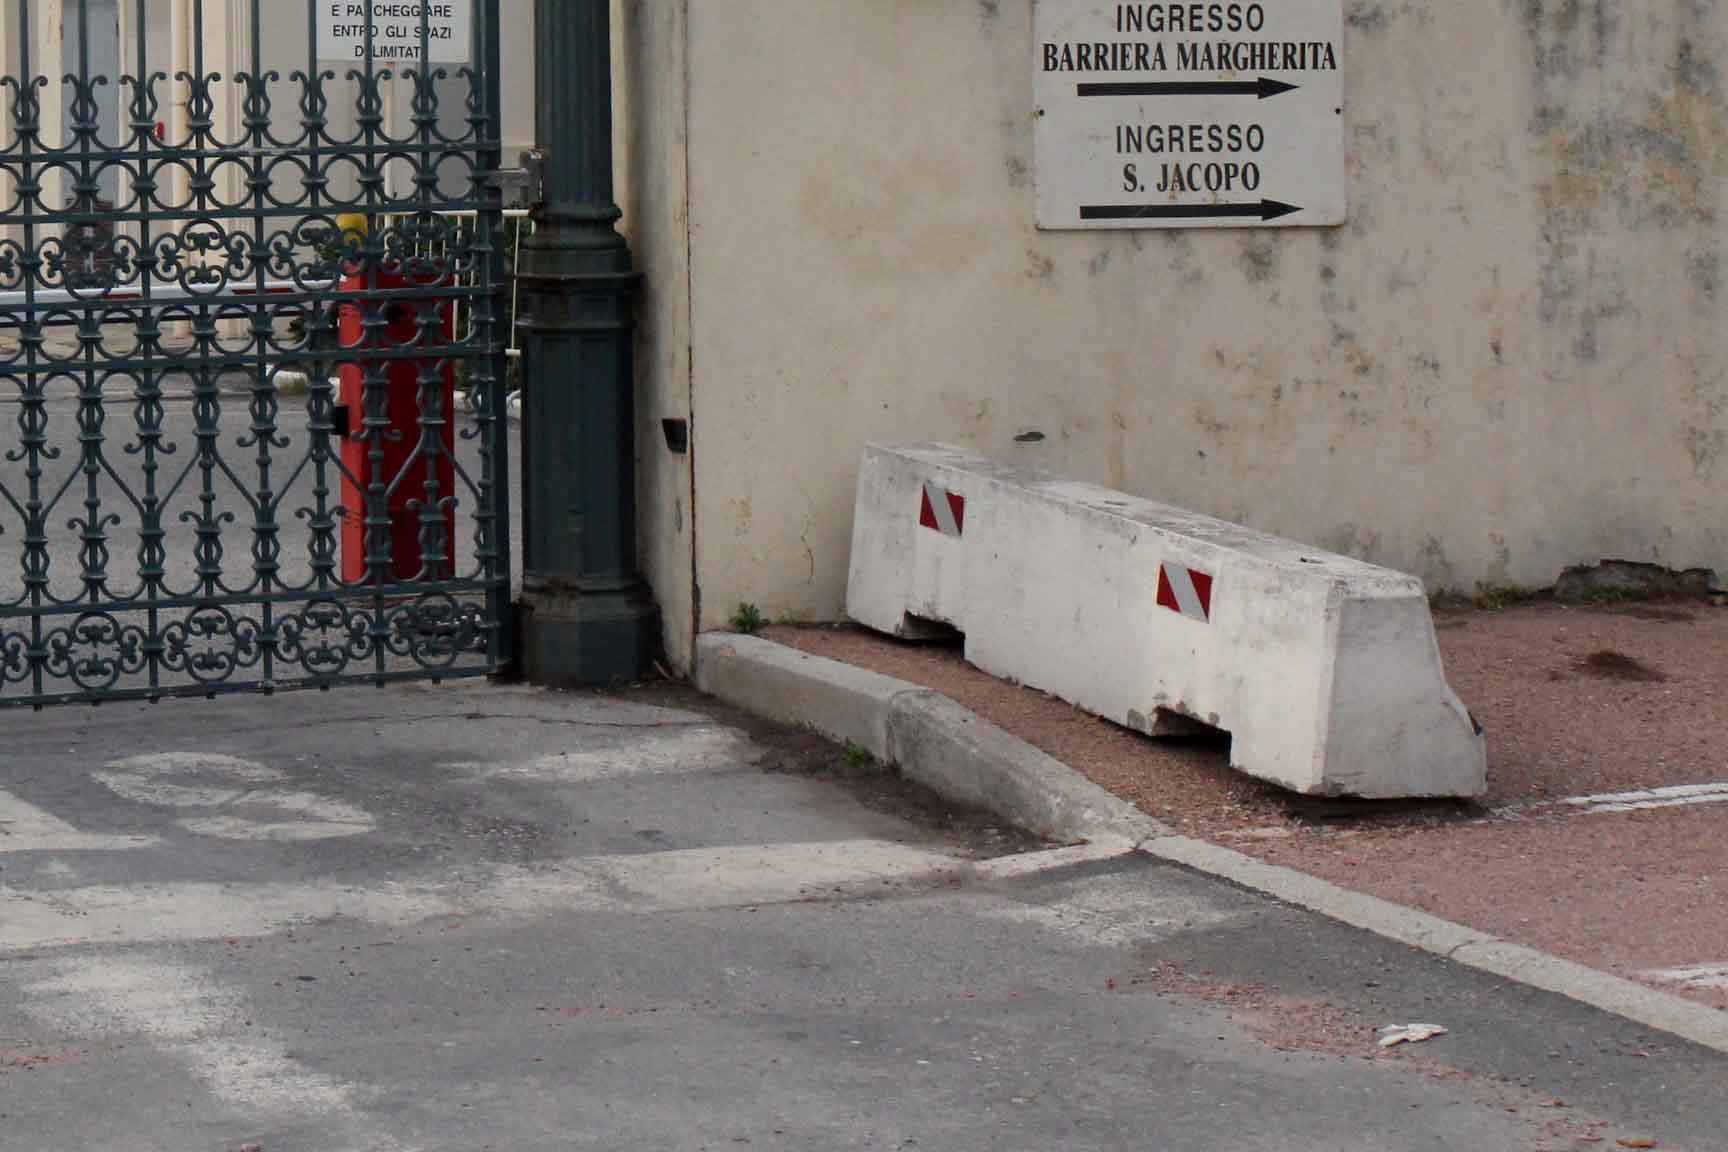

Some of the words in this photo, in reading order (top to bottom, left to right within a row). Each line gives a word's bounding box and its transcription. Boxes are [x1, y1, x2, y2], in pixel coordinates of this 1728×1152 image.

[331, 5, 339, 17] E
[347, 5, 452, 18] PACHEGGARE
[1117, 4, 1264, 33] INGRESSO
[385, 26, 407, 38] GLI
[1042, 42, 1167, 72] BARRIERA
[1176, 41, 1337, 71] MARGHERITA
[1116, 124, 1265, 153] INGRESSO
[1123, 163, 1145, 193] S.
[1156, 162, 1260, 192] JACOPO
